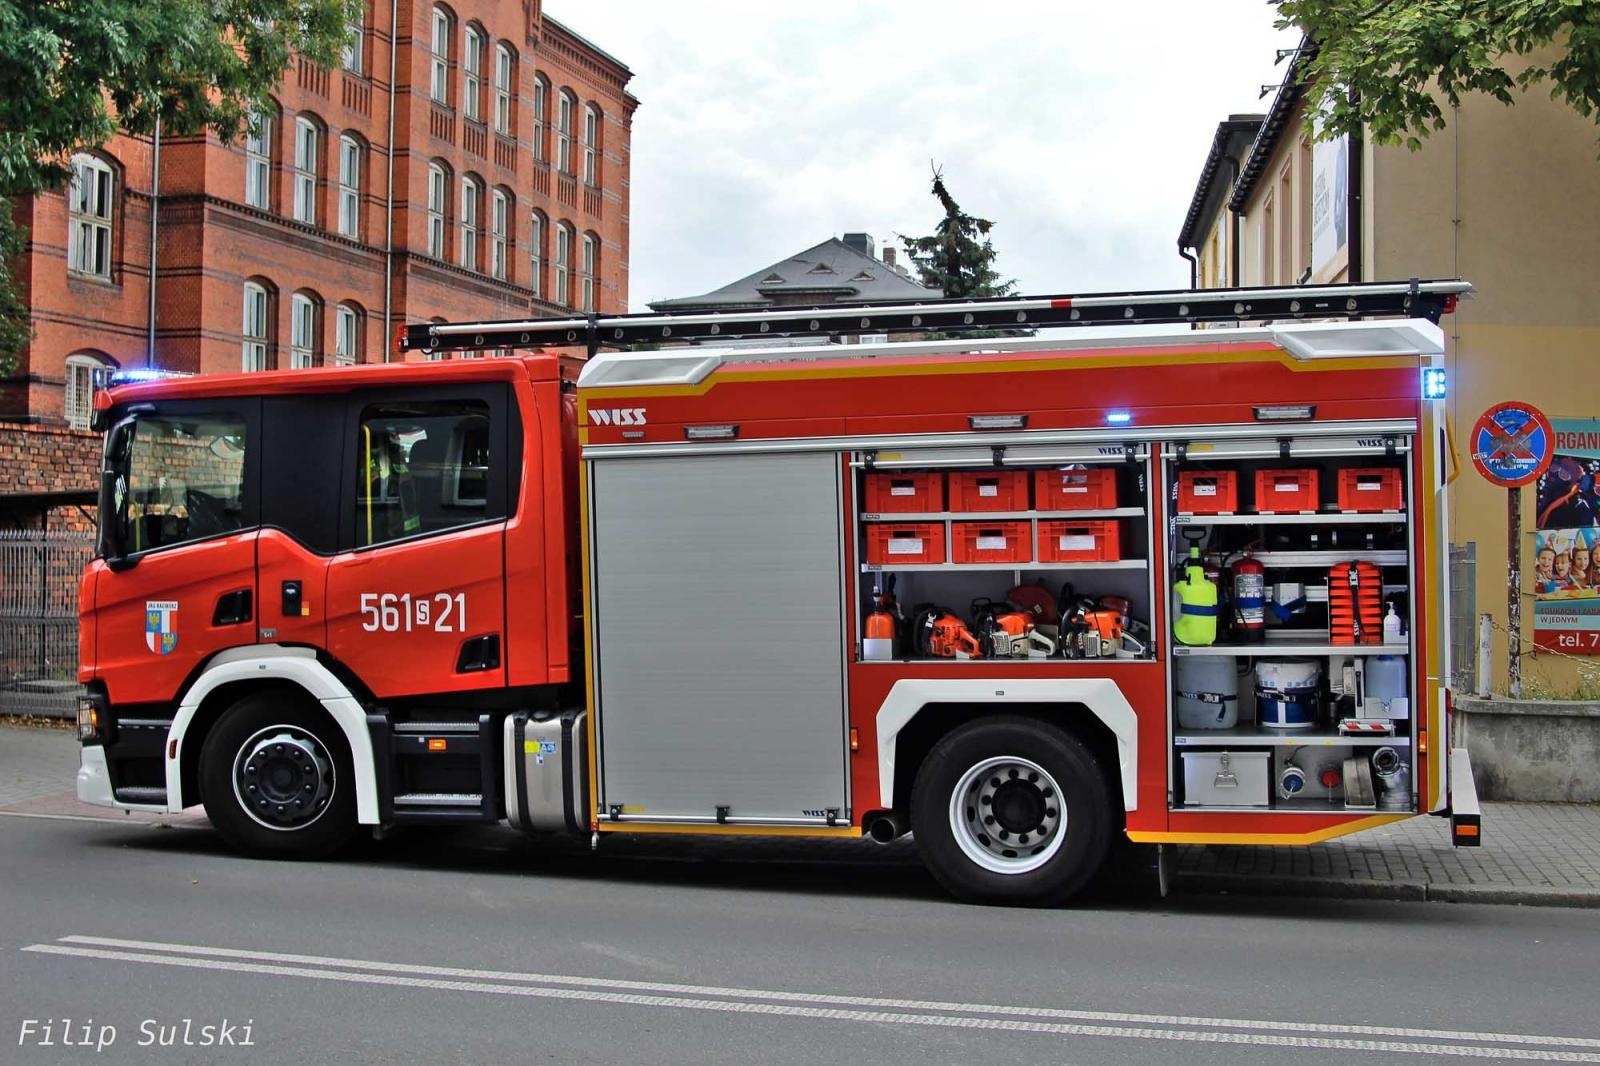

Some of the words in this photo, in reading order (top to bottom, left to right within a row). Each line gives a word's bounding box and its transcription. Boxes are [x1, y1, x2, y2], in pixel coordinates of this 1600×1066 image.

[588, 408, 646, 426] WISS
[1357, 439, 1383, 447] WISS
[1556, 431, 1600, 450] RGAN
[1098, 447, 1122, 455] WISS
[360, 593, 412, 632] 561
[434, 593, 466, 632] 21
[1548, 616, 1578, 624] JEDNYM
[1558, 632, 1585, 647] tel.
[1589, 633, 1600, 647] 7
